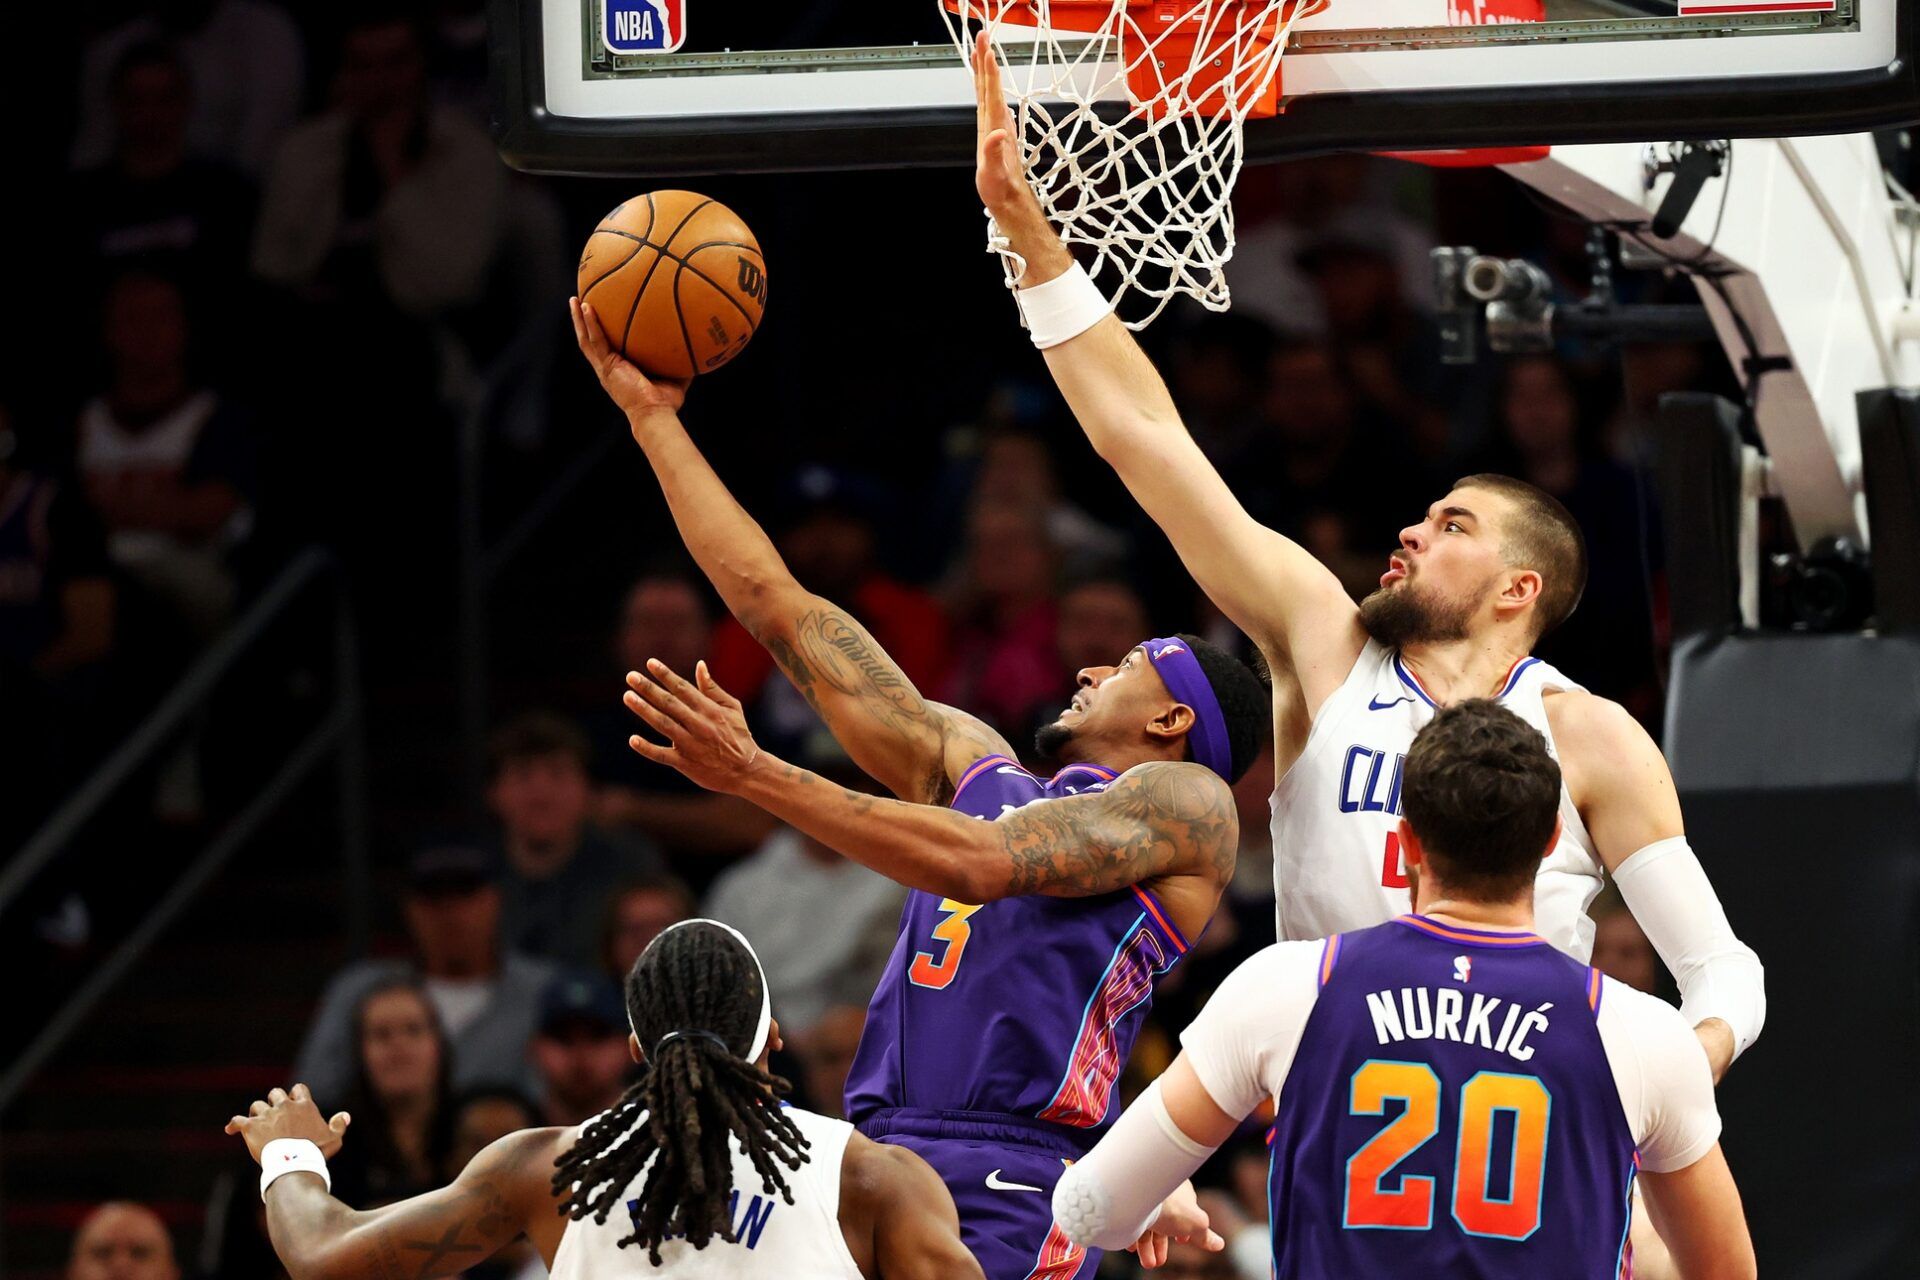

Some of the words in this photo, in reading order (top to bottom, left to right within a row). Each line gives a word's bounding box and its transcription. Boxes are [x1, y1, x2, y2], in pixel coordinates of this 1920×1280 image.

[615, 11, 654, 41] NBA
[908, 897, 984, 990] 3
[1366, 987, 1555, 1061] NURKIĆ
[1342, 1059, 1552, 1242] 20
